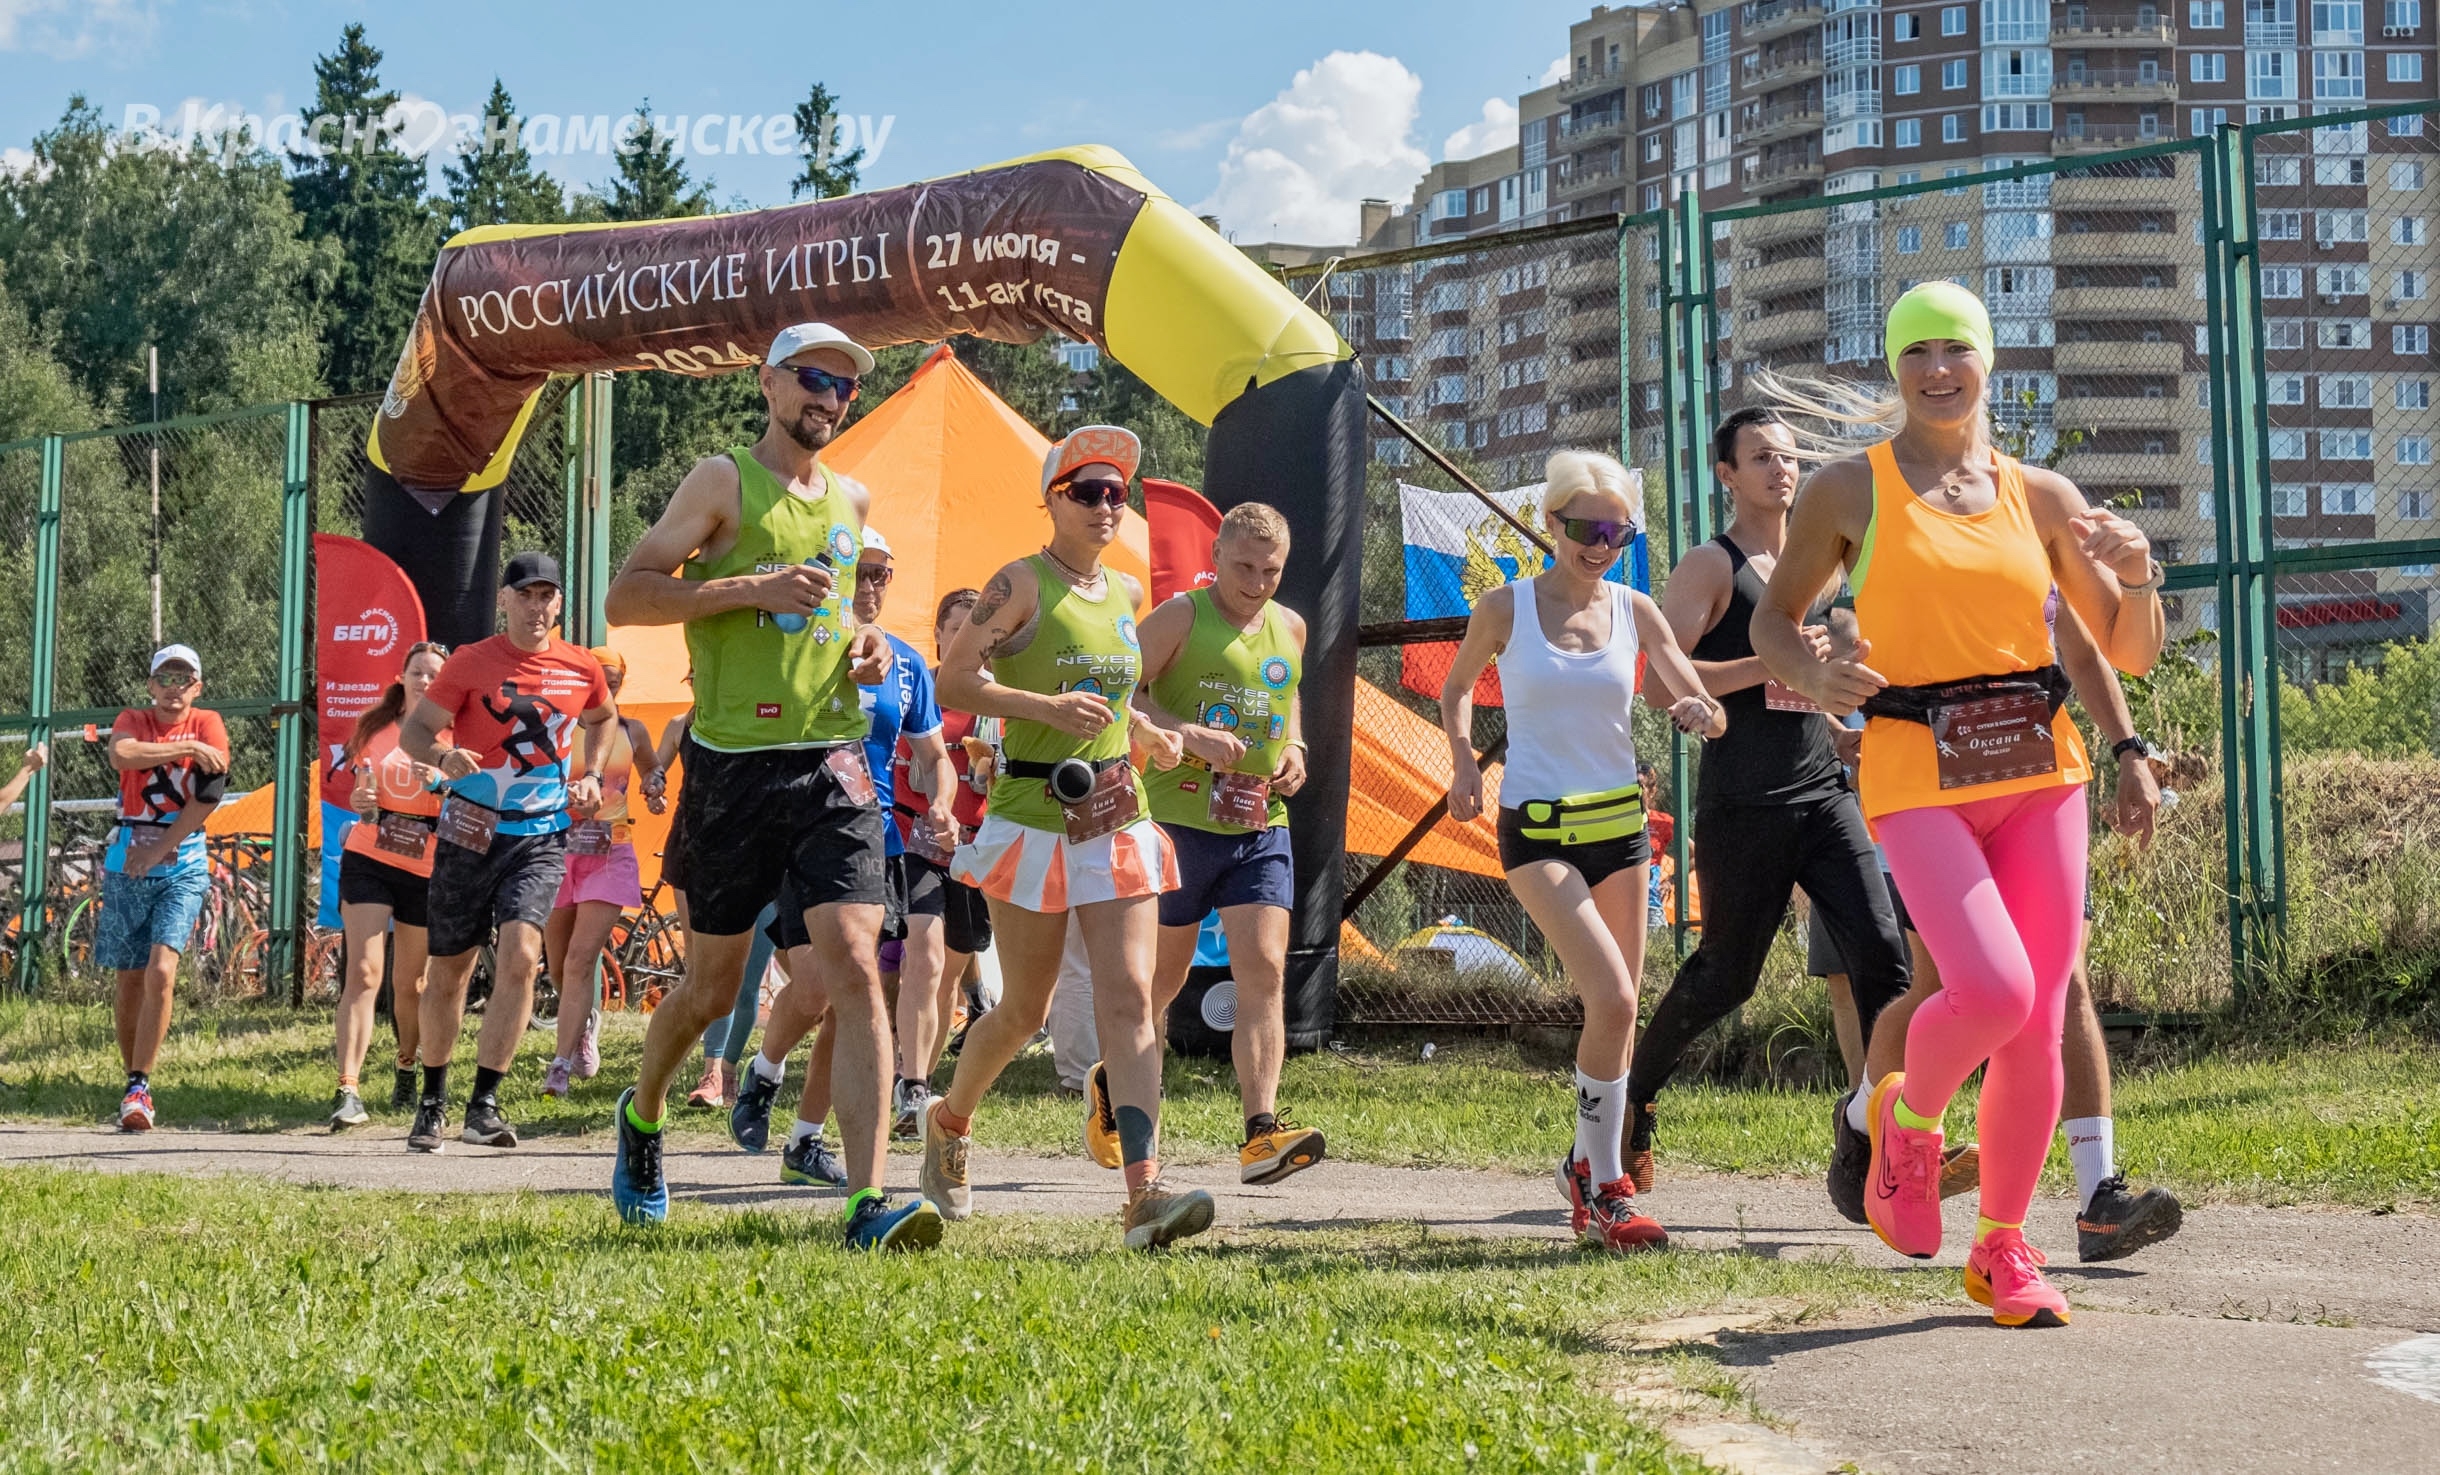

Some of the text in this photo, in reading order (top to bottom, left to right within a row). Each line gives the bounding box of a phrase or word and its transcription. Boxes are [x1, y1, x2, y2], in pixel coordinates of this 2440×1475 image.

[926, 232, 962, 269] 27
[972, 232, 1060, 267] июля
[458, 232, 892, 338] РОССИЙСКИЕ ИГРЫ
[937, 281, 988, 312] 11
[635, 341, 762, 375] 2024
[333, 625, 390, 641] БЕГИ
[1056, 654, 1136, 666] NEVER
[1089, 666, 1137, 675] GIVE
[326, 681, 380, 692] И звезды
[1107, 677, 1134, 685] UP
[1200, 680, 1270, 699] NEVER
[1223, 694, 1269, 709] GIVE
[1243, 708, 1269, 717] UP
[1970, 734, 2020, 749] Оксана
